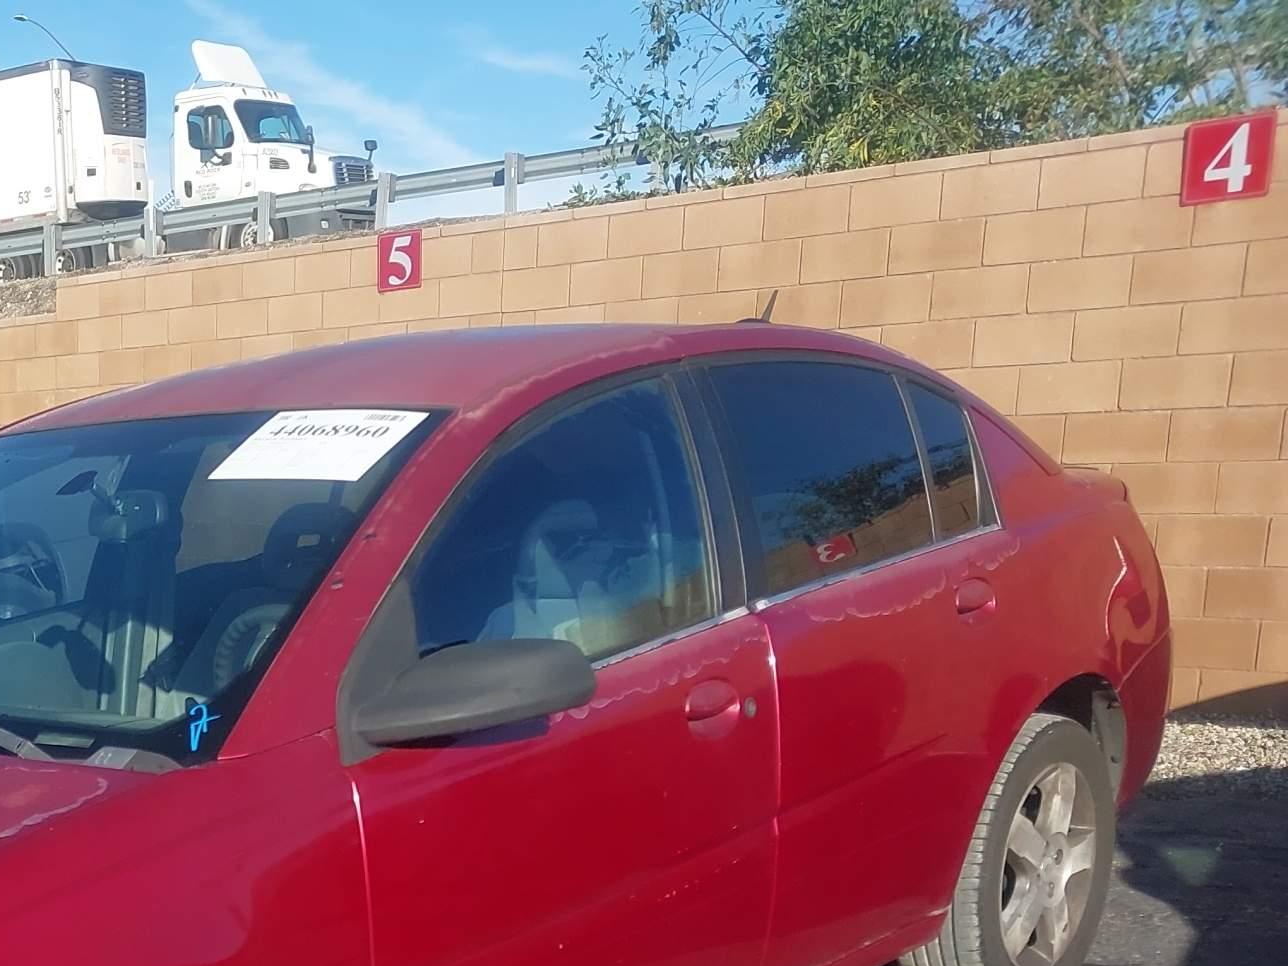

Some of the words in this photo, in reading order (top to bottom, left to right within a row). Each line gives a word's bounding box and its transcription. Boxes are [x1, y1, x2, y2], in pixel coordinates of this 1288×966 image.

[1203, 122, 1253, 193] 4
[388, 235, 412, 286] 5
[269, 424, 390, 438] 44068960
